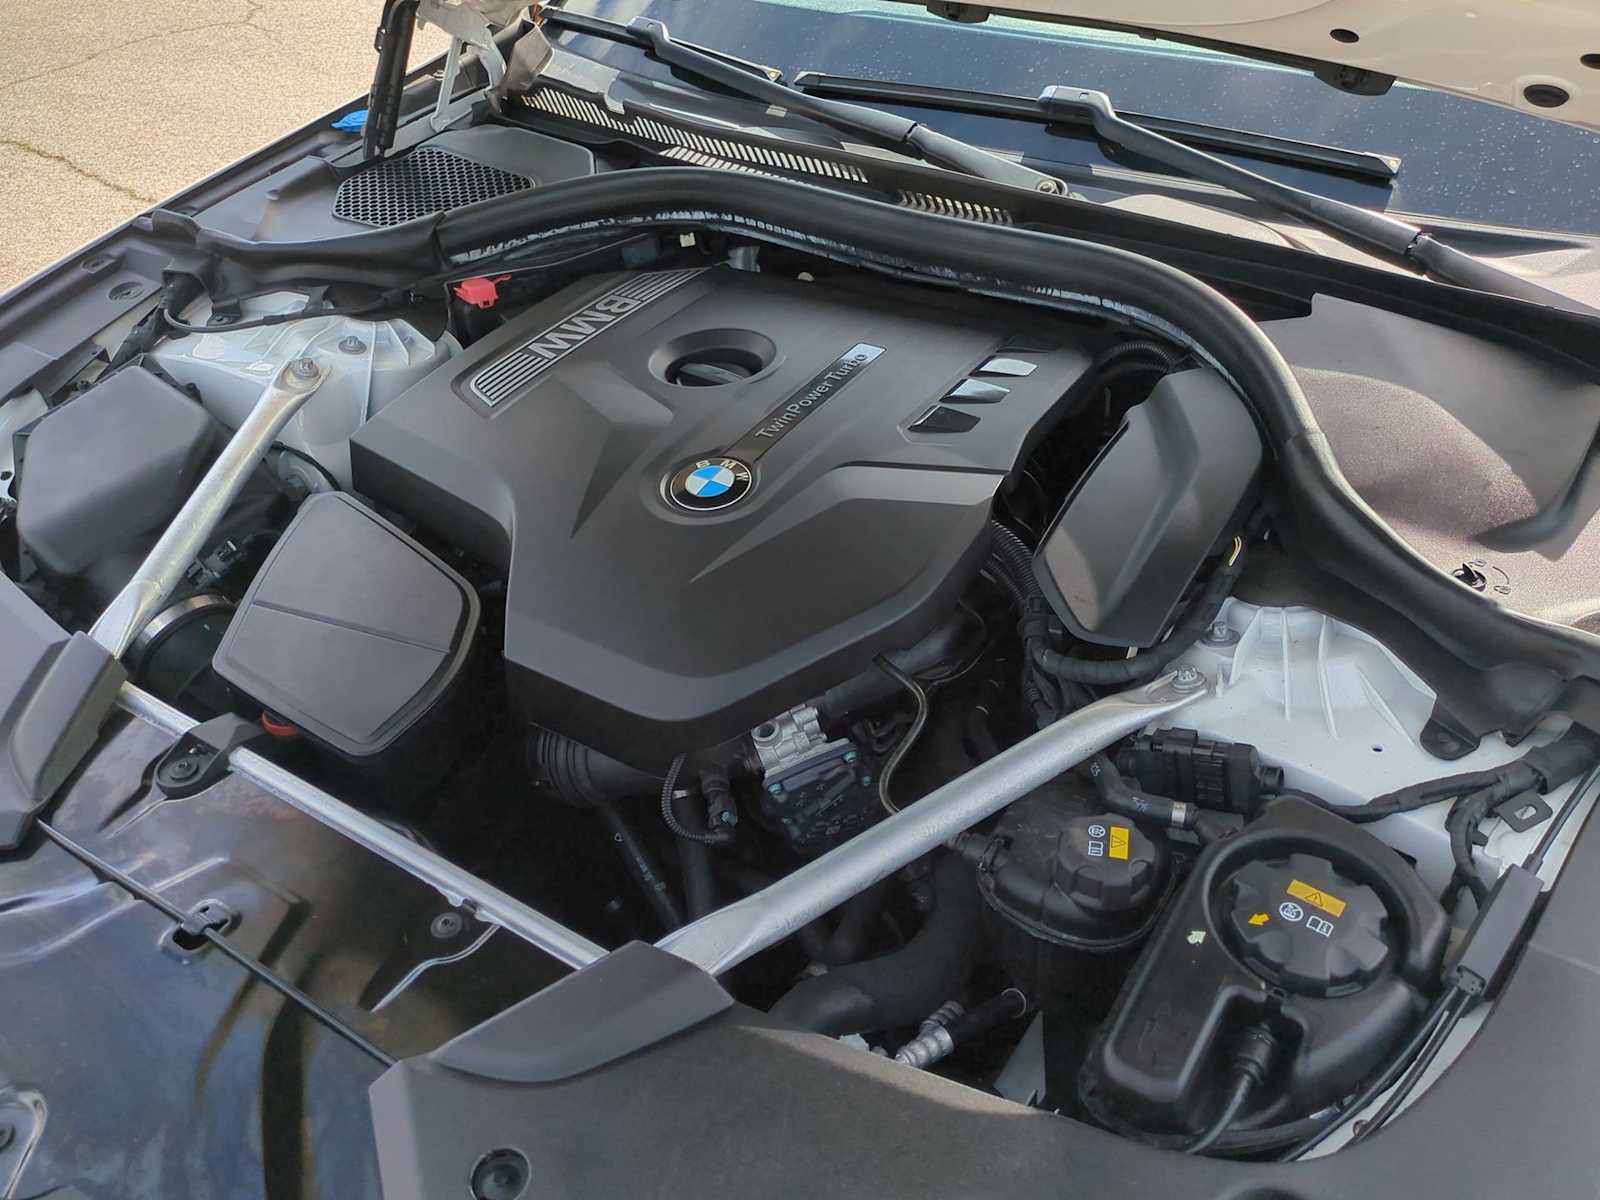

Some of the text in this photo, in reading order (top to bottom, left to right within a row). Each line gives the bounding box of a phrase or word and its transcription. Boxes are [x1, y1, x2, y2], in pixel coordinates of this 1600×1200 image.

[527, 295, 642, 360] BMW
[755, 354, 868, 438] TwinPowerTurbo
[695, 459, 749, 482] BMW
